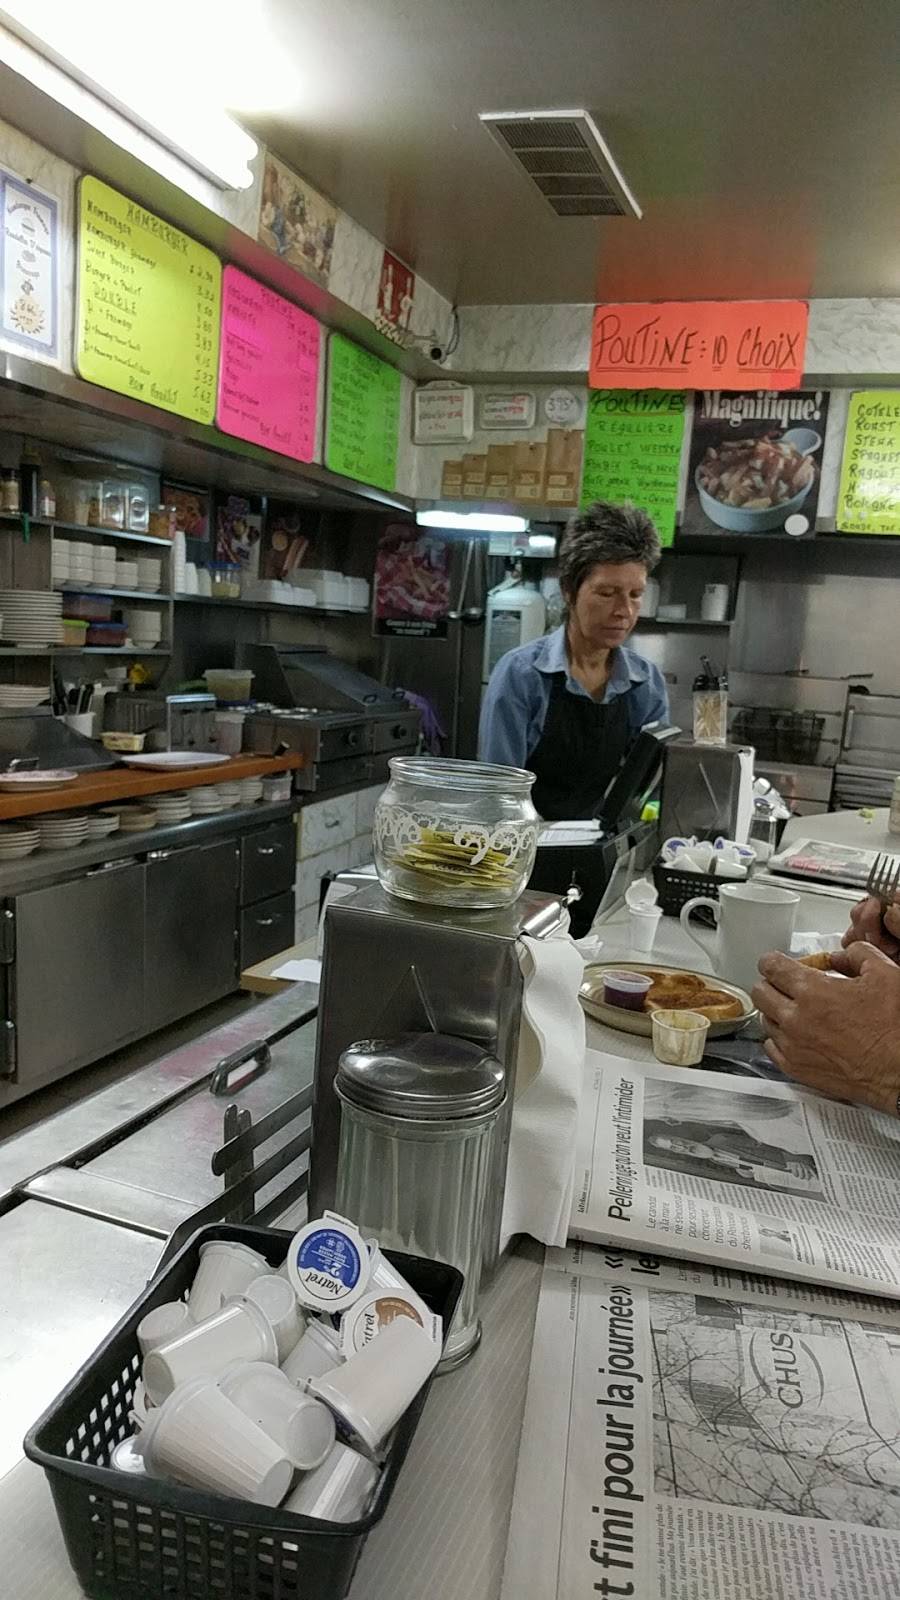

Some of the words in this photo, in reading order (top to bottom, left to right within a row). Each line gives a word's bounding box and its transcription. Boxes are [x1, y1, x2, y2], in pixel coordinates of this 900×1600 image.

[611, 1078, 634, 1124] l'intimider
[612, 1124, 631, 1144] veut
[305, 1271, 343, 1295] Natrel
[361, 1313, 375, 1347] atrel
[770, 1332, 803, 1409] CHUS
[596, 1384, 634, 1409] la
[603, 1413, 644, 1502] pour
[590, 1505, 635, 1570] fini
